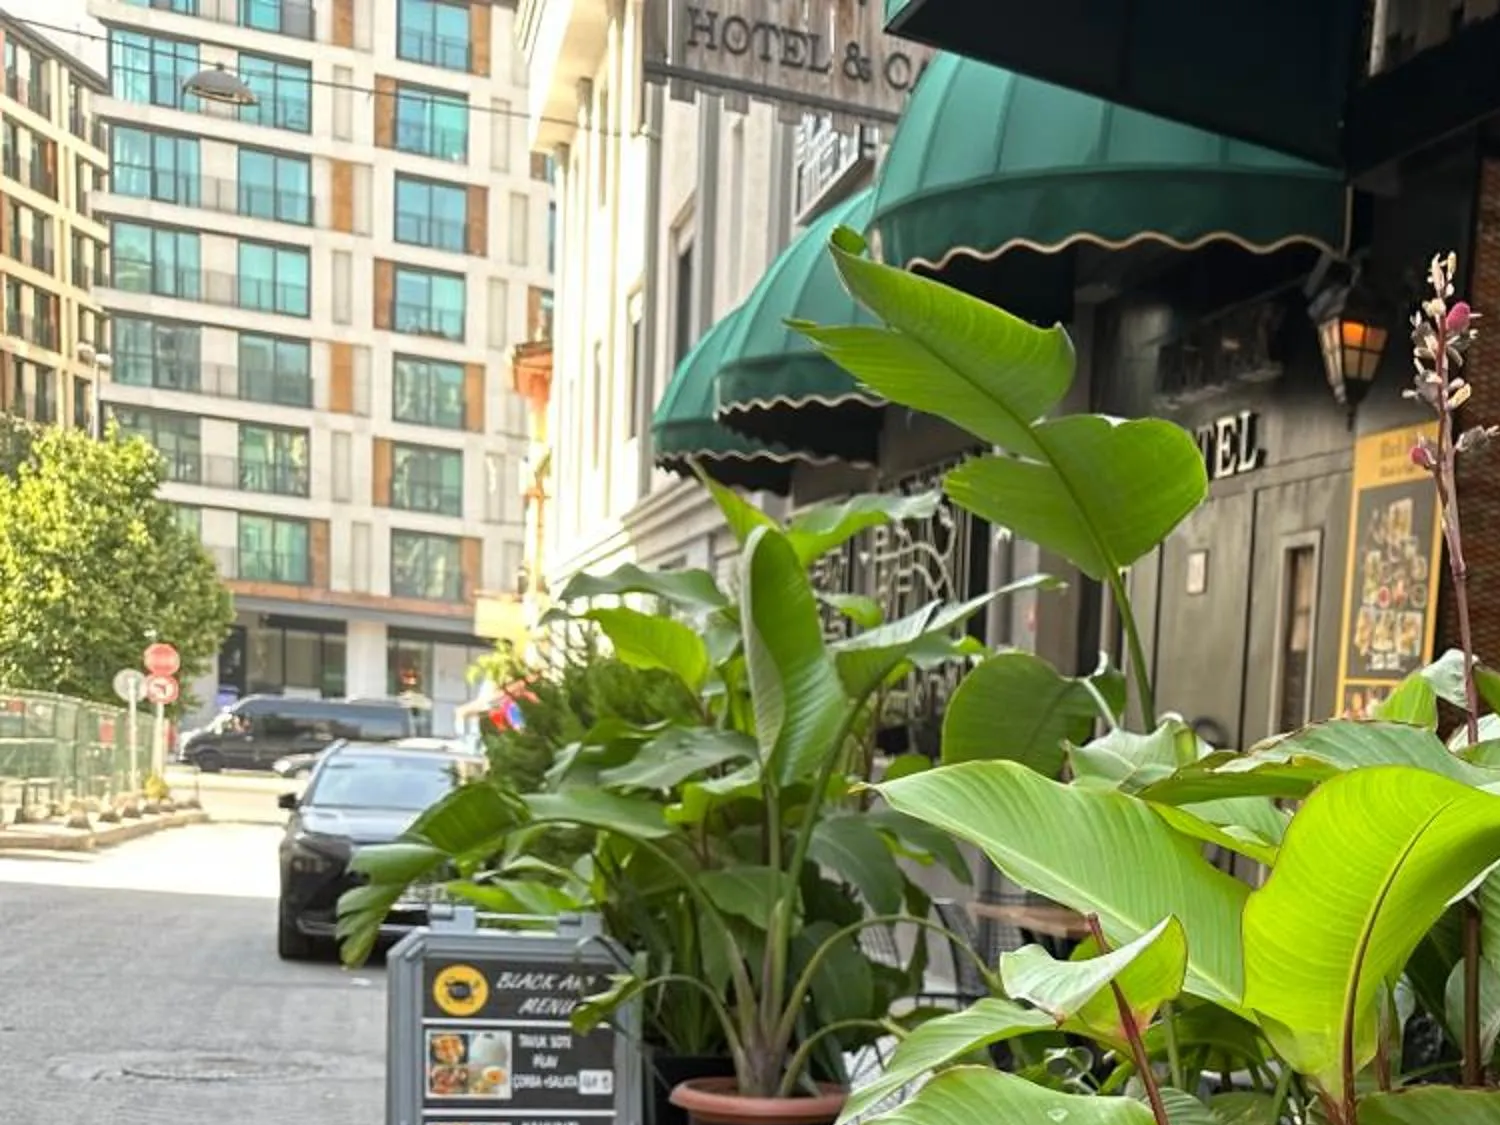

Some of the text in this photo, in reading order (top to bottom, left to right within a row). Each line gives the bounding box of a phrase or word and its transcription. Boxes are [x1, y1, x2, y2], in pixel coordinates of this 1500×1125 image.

[687, 7, 832, 74] HOTEL
[844, 41, 872, 84] &
[1197, 408, 1260, 479] TEL
[496, 971, 559, 990] BLACK
